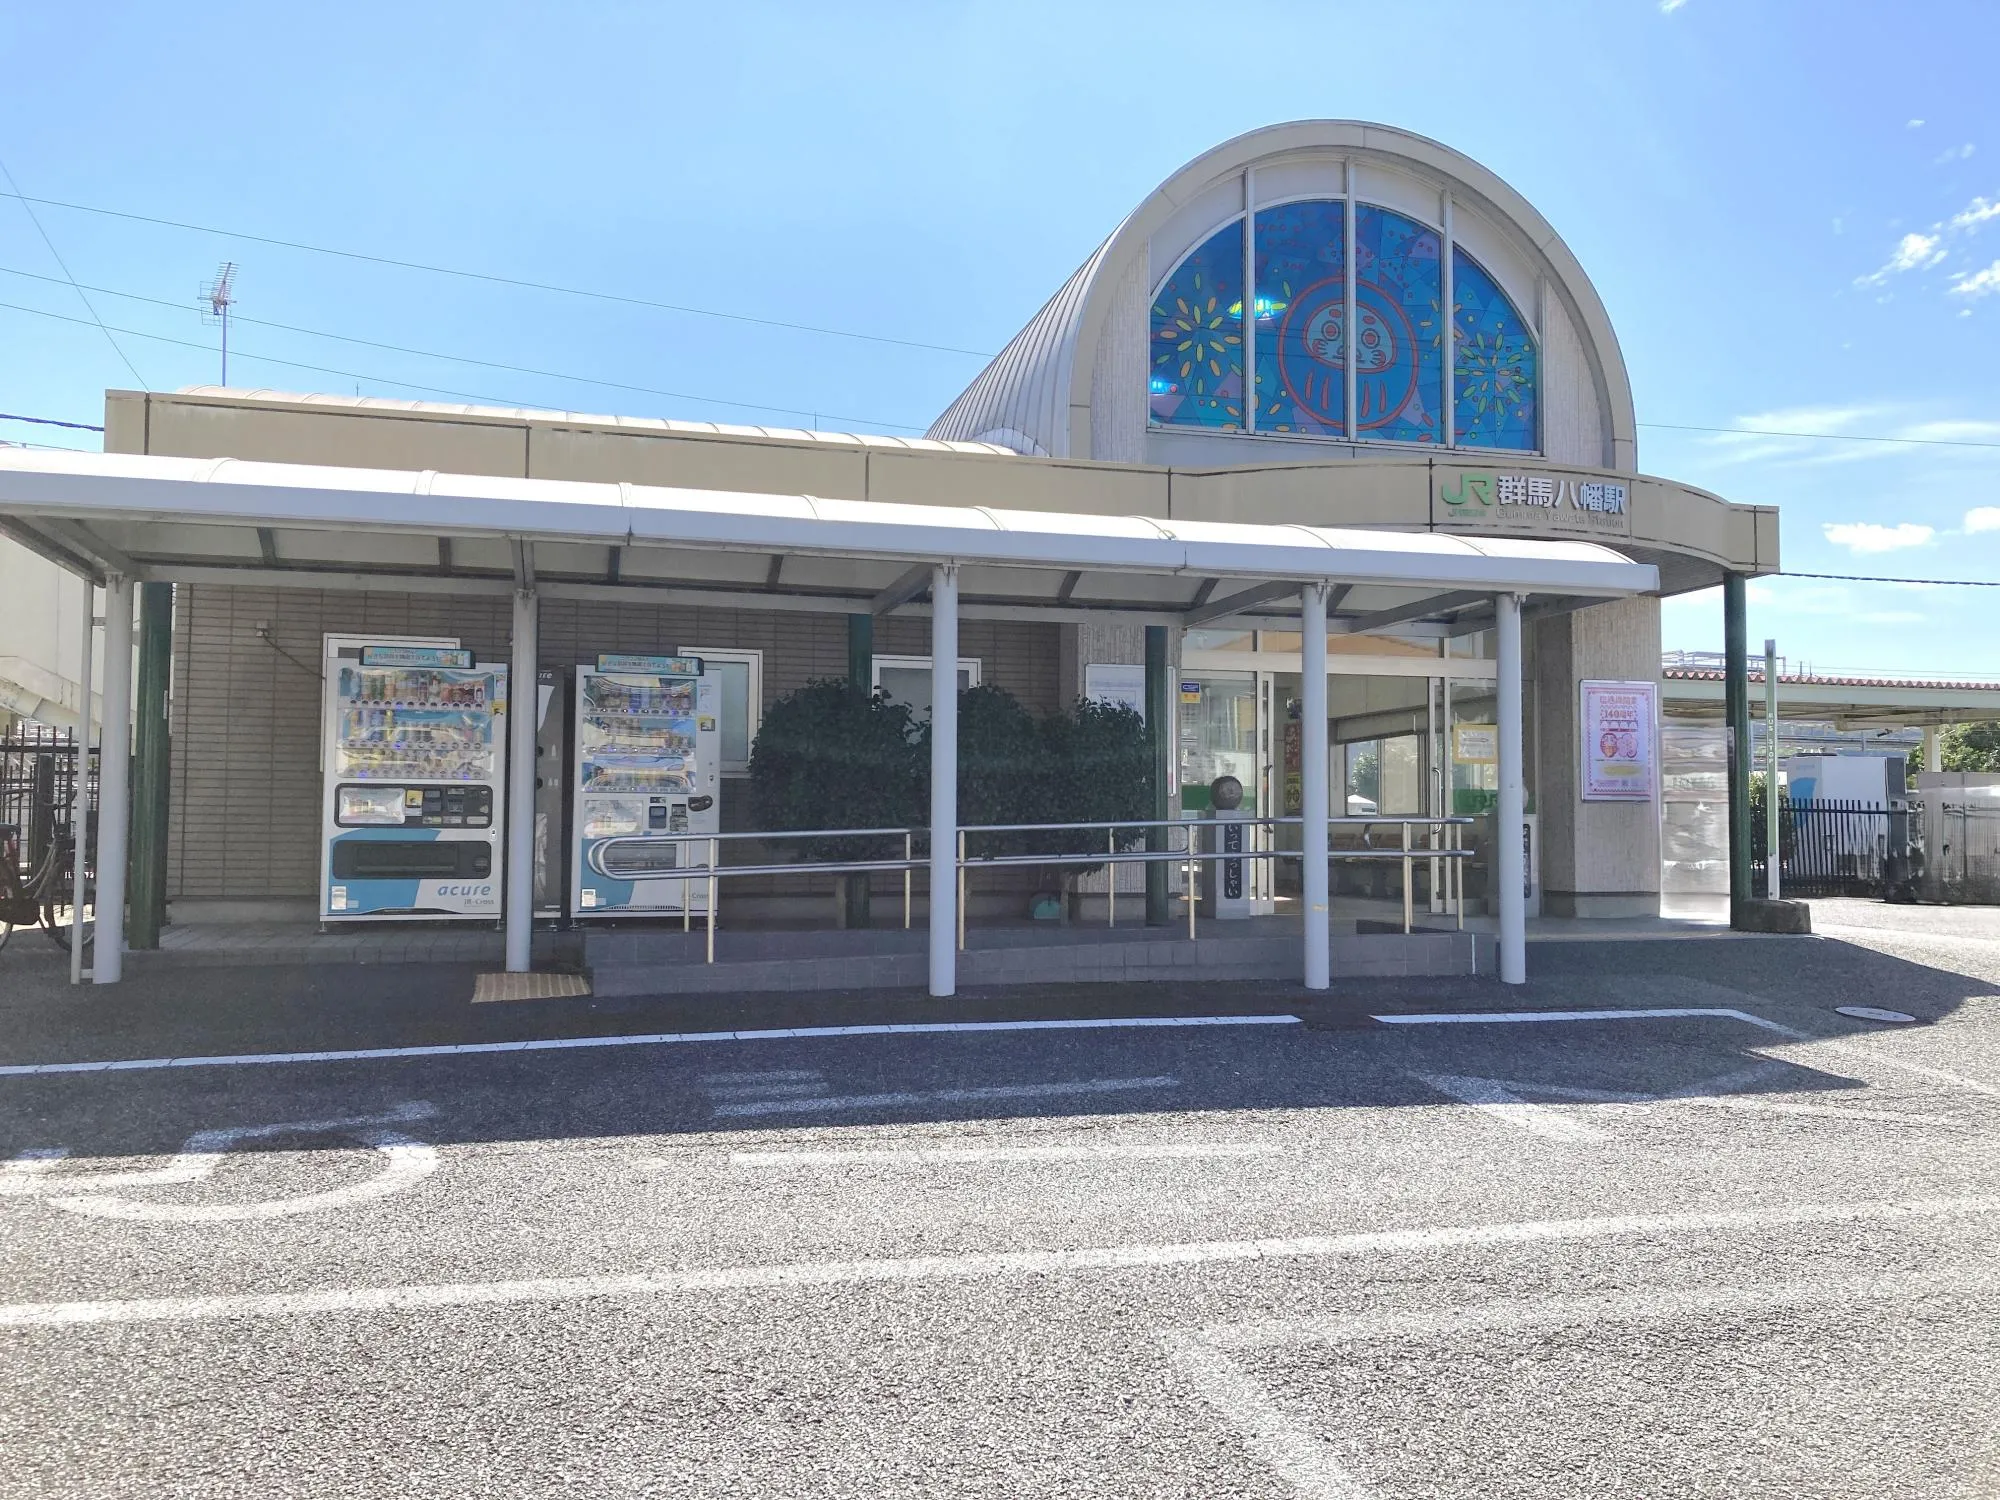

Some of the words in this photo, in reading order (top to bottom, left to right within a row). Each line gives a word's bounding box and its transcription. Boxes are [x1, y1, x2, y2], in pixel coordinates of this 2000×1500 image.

[1442, 473, 1494, 506] JR
[1497, 475, 1627, 515] 群馬八幡駅
[437, 885, 491, 896] acure
